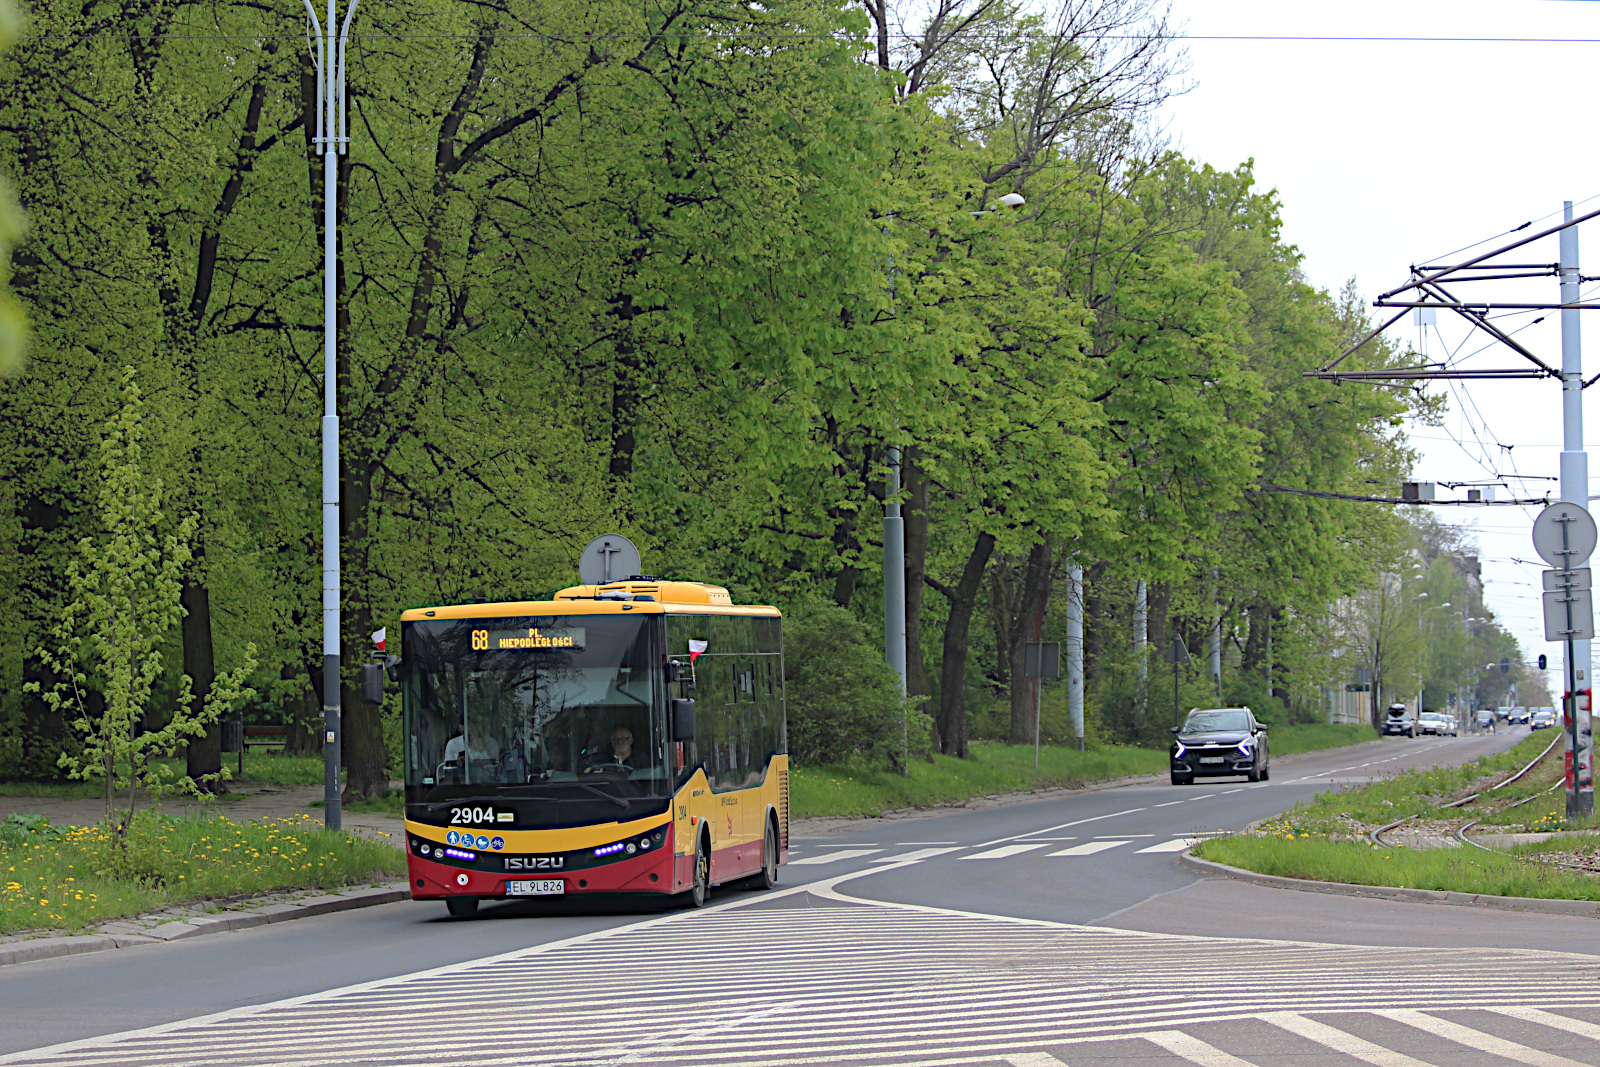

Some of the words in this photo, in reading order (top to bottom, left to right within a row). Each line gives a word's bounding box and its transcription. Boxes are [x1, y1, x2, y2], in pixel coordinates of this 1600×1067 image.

[529, 628, 543, 638] PL.
[472, 630, 489, 650] 68
[451, 806, 495, 824] 2904
[504, 857, 564, 870] ISUZU
[512, 881, 526, 893] EL
[529, 881, 562, 892] 9L826
